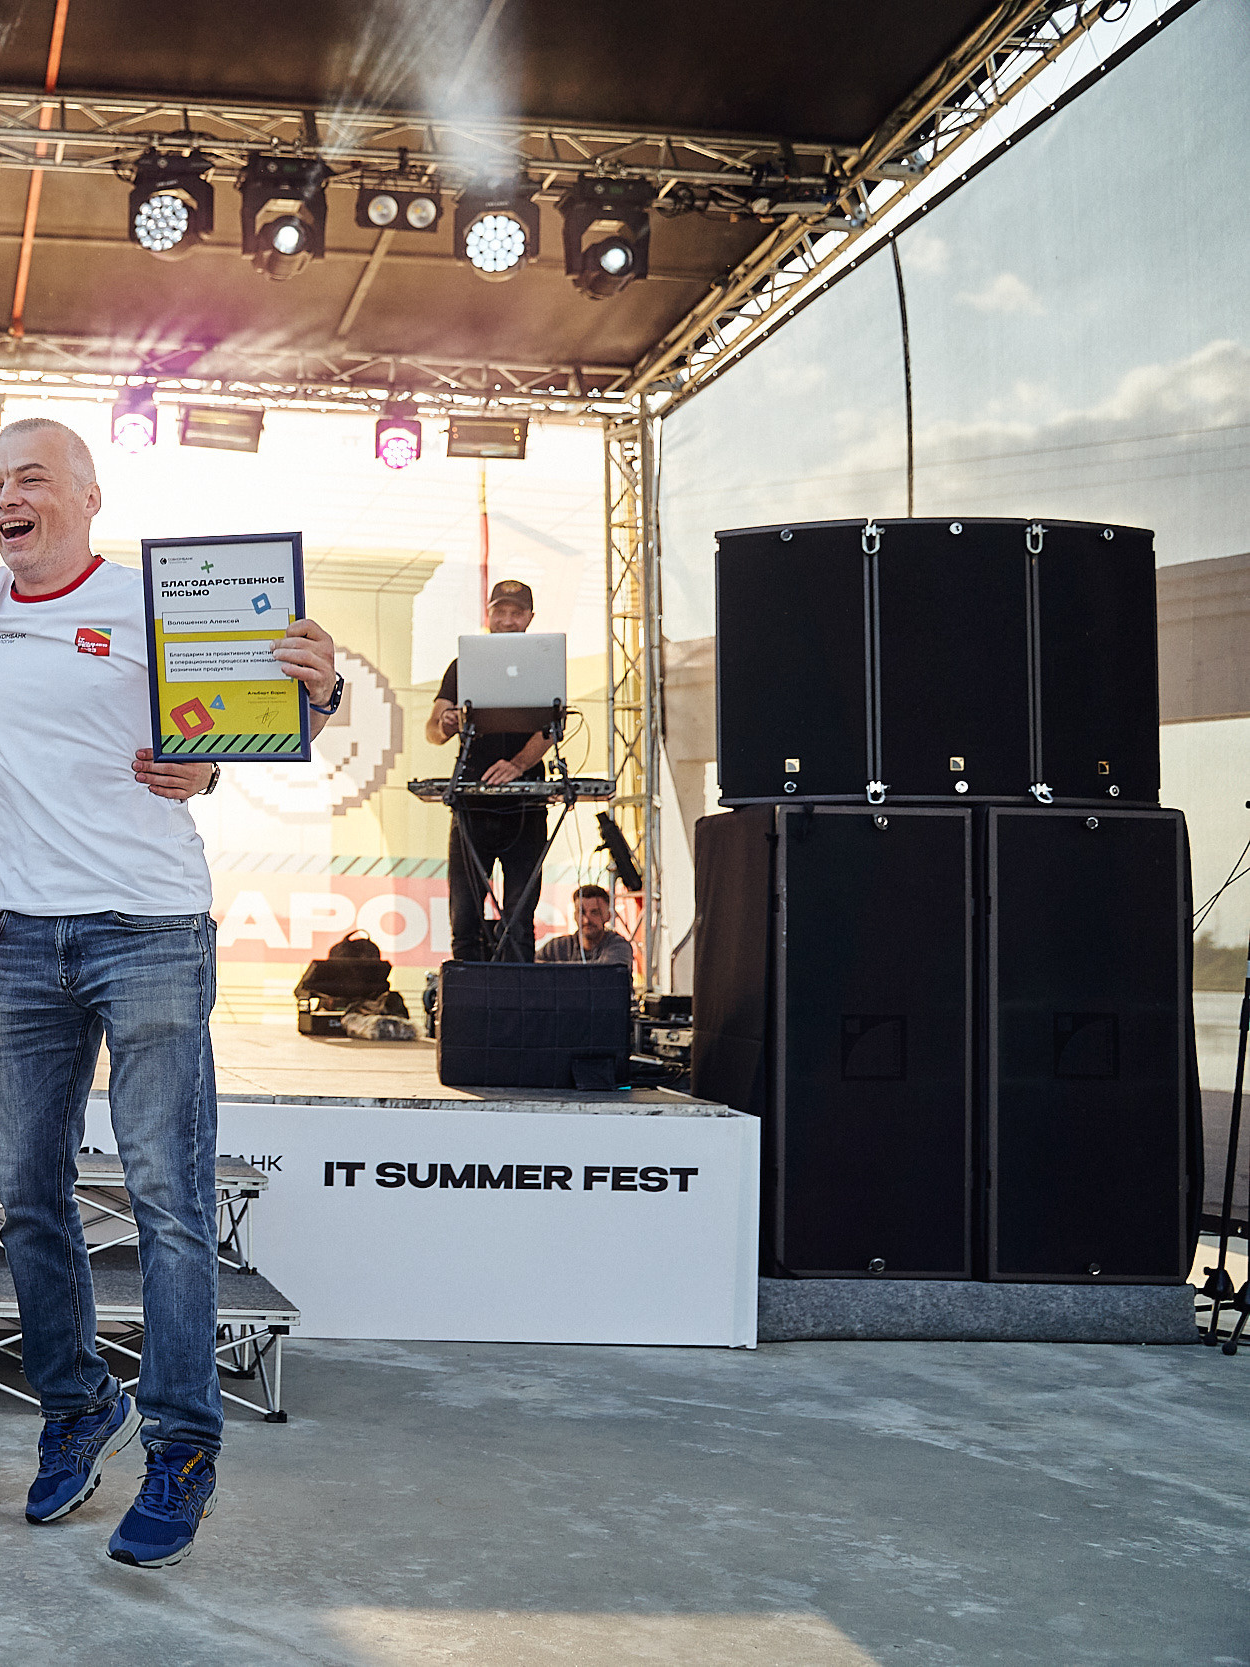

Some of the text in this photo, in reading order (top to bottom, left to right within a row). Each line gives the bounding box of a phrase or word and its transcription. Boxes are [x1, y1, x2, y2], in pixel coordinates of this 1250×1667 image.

[161, 576, 285, 588] БЛАГОДАРСТВЕННОЕ
[161, 589, 210, 598] ПИСЬМО
[324, 1161, 699, 1192] IT SUMMER FEST
